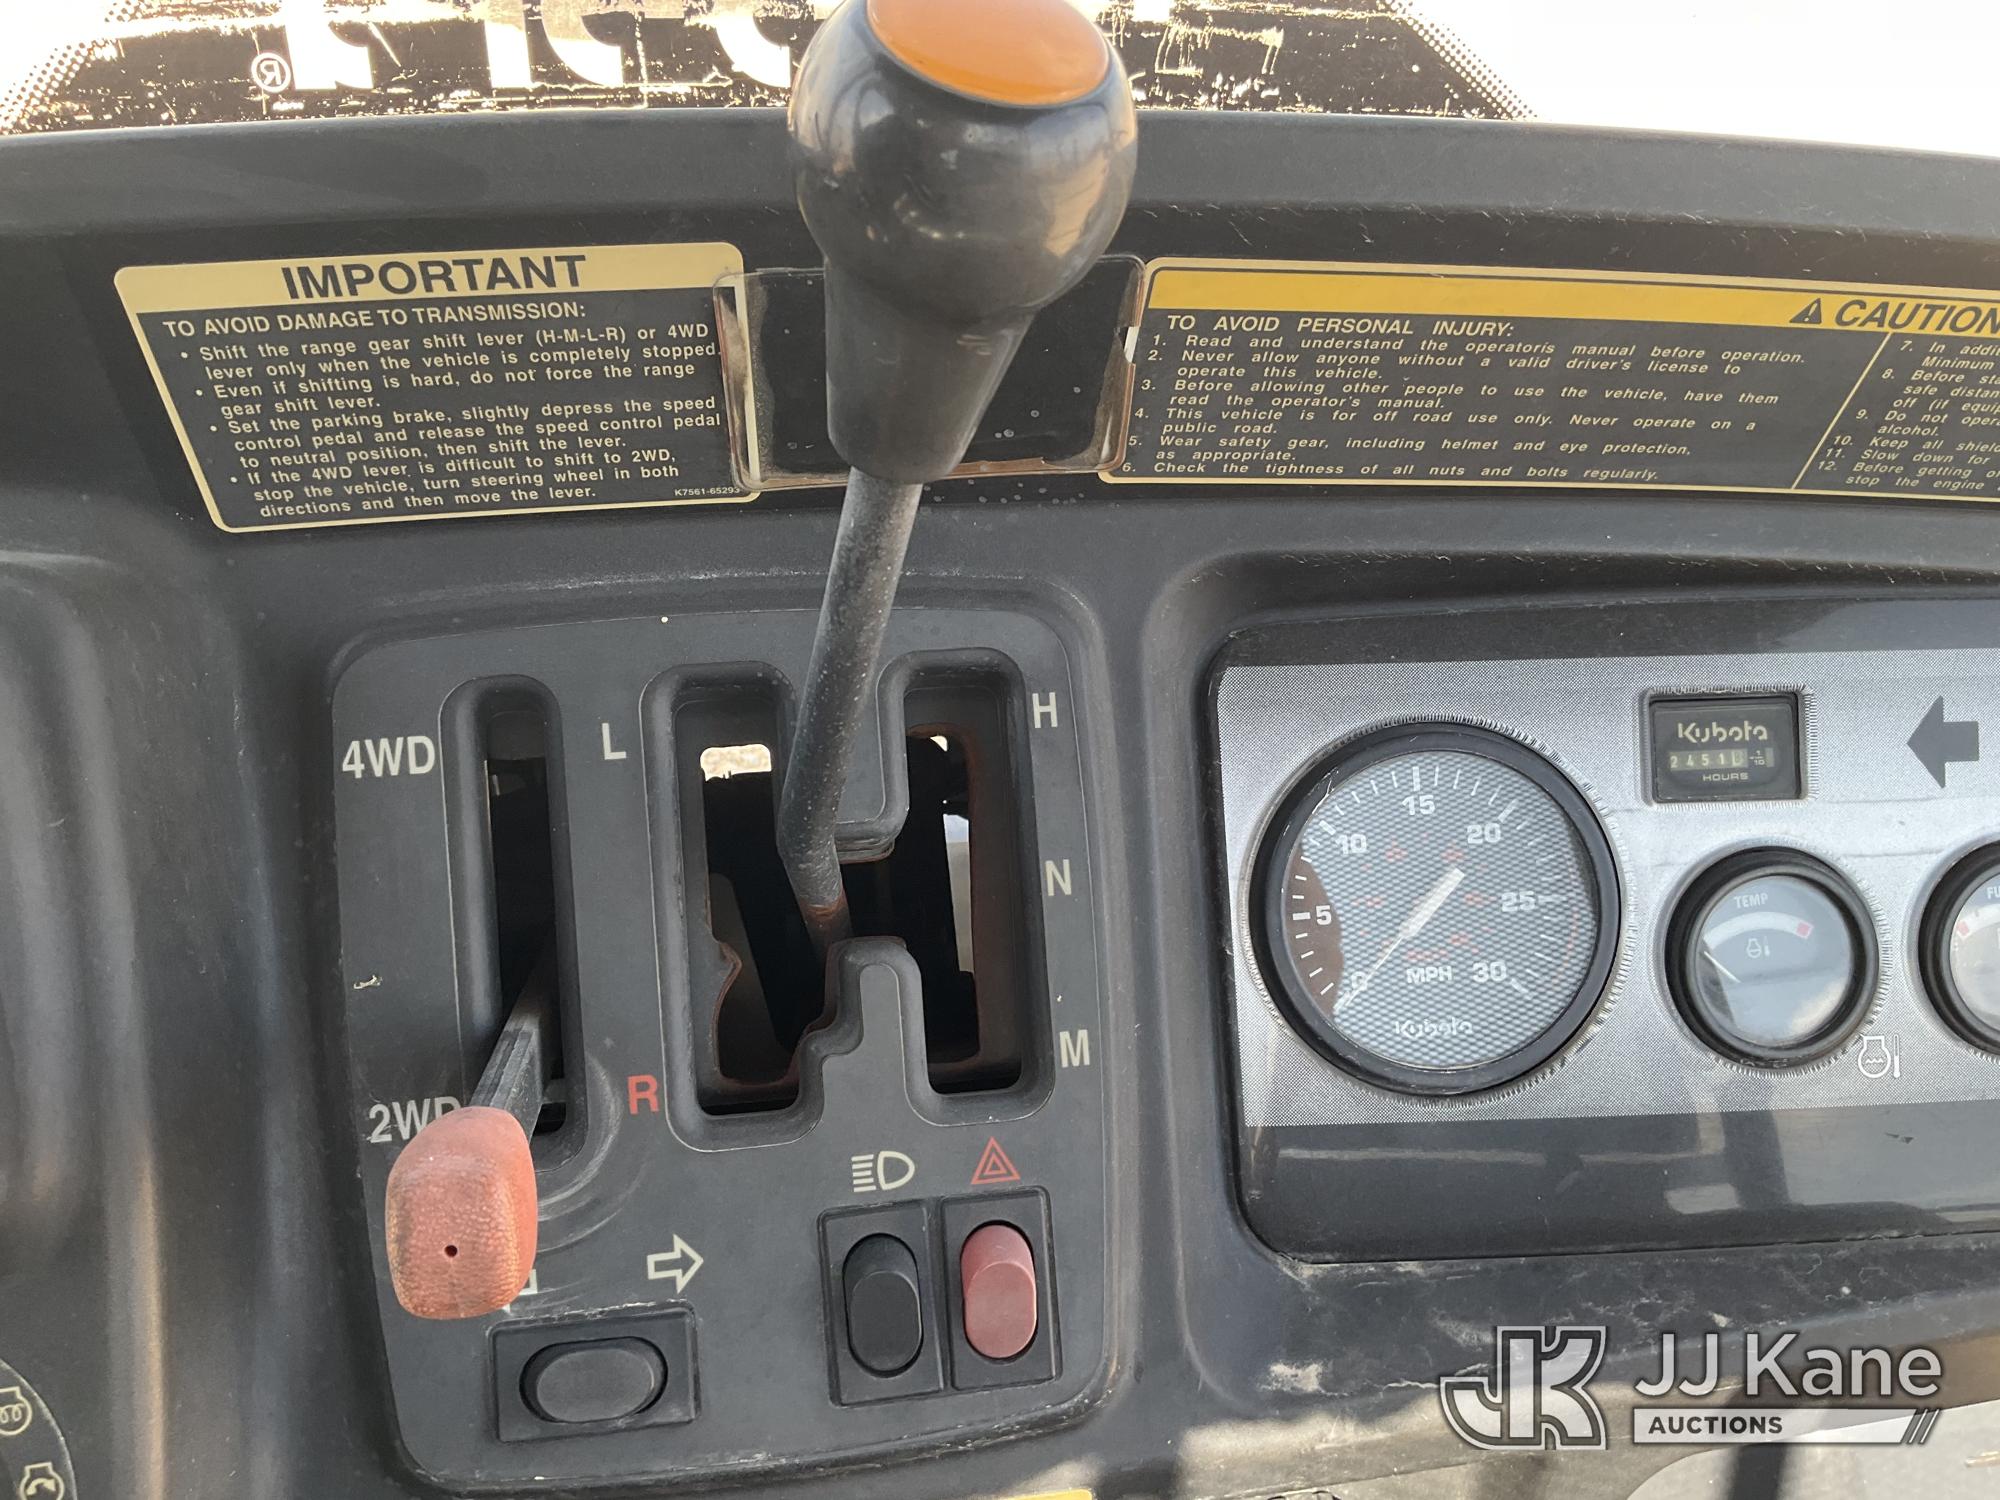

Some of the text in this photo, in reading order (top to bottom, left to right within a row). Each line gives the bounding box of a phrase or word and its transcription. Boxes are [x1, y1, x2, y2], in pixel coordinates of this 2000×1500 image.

[281, 254, 586, 299] IMPORTANT
[205, 302, 586, 335] AVOID DAMAGE TRANSMISSION:
[1213, 316, 1514, 337] AVOID PERSONAL INJURY:
[1834, 299, 2000, 334] CAUTION
[199, 323, 708, 361] Shift the range gear shift lever (H-M-L-R) 4WD
[1186, 334, 1232, 347] Read
[1249, 336, 1283, 348] and
[1300, 337, 1404, 350] understand
[1572, 344, 1636, 356] manual
[1650, 346, 1706, 359] before
[1721, 351, 1805, 363] operation.
[205, 366, 253, 380] lever
[266, 361, 306, 378] only
[318, 358, 369, 373] when
[380, 356, 411, 370] the
[421, 352, 490, 368] vehicle
[529, 346, 630, 364] completely
[1177, 366, 1382, 379] operate this vehicle.
[1182, 350, 1709, 373] Never allow anyone without valid driver's license
[1921, 356, 1995, 370] Minimum
[213, 364, 695, 398] Even shifting hard, not force range
[1910, 369, 1965, 383] Before
[1174, 379, 1779, 404] Before allowing other people vehicle, have them
[1903, 384, 1938, 395] safe
[220, 396, 380, 420] gear shift lever.
[1170, 394, 1444, 409] read operator's manual.
[228, 396, 715, 434] Set parking brake, slightly depress speed
[1166, 408, 1696, 429] This vehicle road only. Never operate
[234, 413, 720, 452] control pedal and release speed control pedal
[1162, 422, 1277, 435] public road.
[270, 436, 626, 466] neutral position, then shift lever.
[1160, 435, 1690, 456] Wear safety gear, including helmet protection.
[1869, 436, 1909, 450] Keep
[312, 466, 352, 480] 4WD
[363, 465, 407, 477] lever
[445, 456, 516, 472] difficult
[554, 452, 594, 466] shift
[1192, 450, 1296, 462] appropriate.
[1861, 449, 1954, 463] Slow down
[1154, 462, 1658, 482] Check tightness nuts bolts regularly.
[1852, 462, 1972, 479] Before getting
[254, 465, 679, 502] stop vehicle, turn steering wheel both
[1846, 475, 1985, 491] stop engine
[260, 487, 596, 517] directions and then move lever.
[1032, 692, 1058, 729] H
[601, 722, 627, 760] L
[1678, 720, 1768, 743] Kubota
[342, 735, 436, 779] 4WD
[1702, 772, 1749, 782] HOURS
[1402, 794, 1436, 816] 15
[1335, 833, 1367, 854] 10
[1467, 823, 1501, 844] 20
[1045, 859, 1072, 896] N
[1501, 890, 1536, 912] 25
[1734, 893, 1768, 908] TEMP
[1316, 905, 1332, 925] 5
[1406, 965, 1452, 984] MPH
[1473, 961, 1507, 983] 30
[1059, 1029, 1090, 1068] M
[628, 1075, 659, 1115] R
